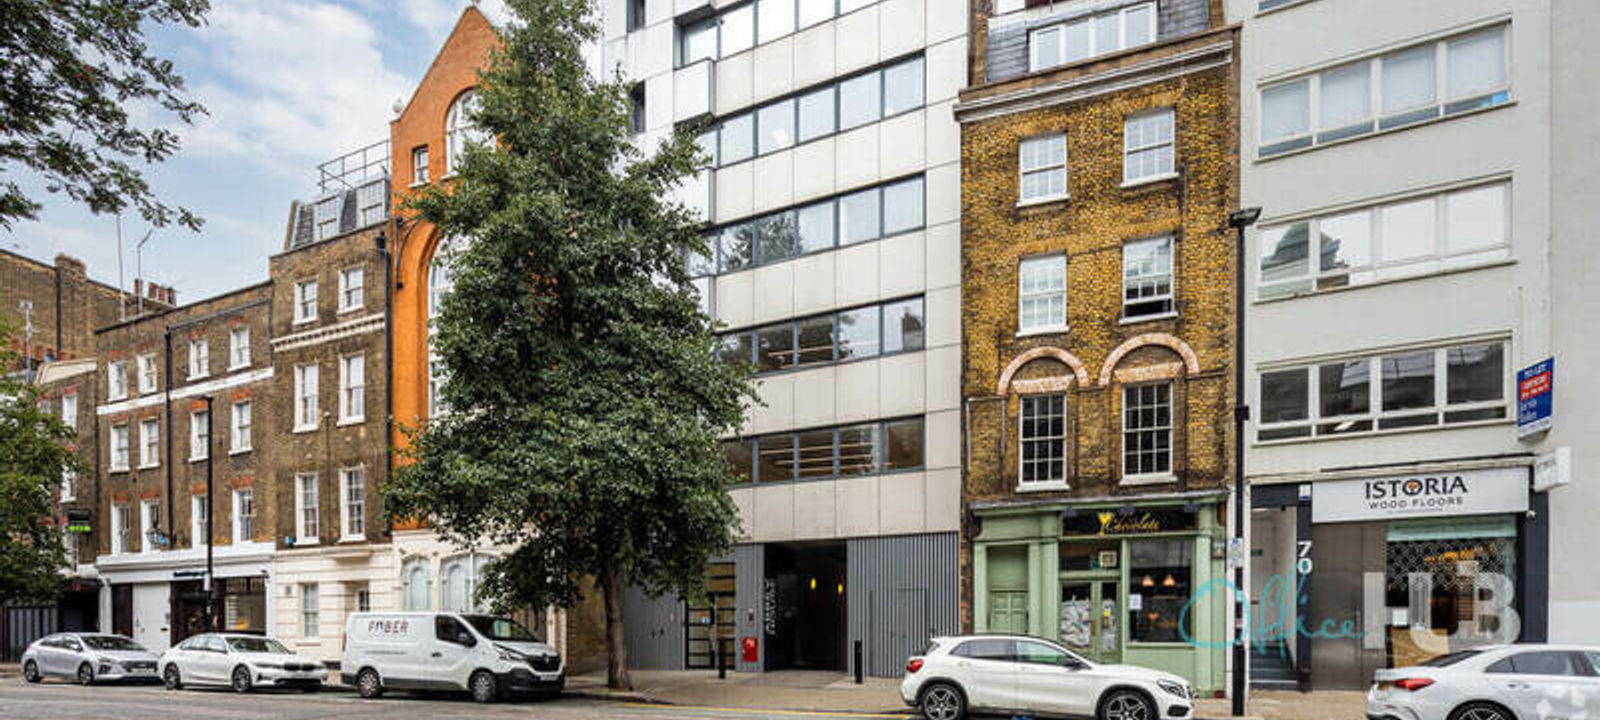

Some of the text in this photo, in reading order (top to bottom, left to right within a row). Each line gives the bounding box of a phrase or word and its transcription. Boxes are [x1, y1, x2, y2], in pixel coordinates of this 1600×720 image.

[1364, 476, 1469, 500] ISTORIA
[1368, 496, 1464, 510] WOOD FLOORS
[1298, 541, 1313, 575] 70
